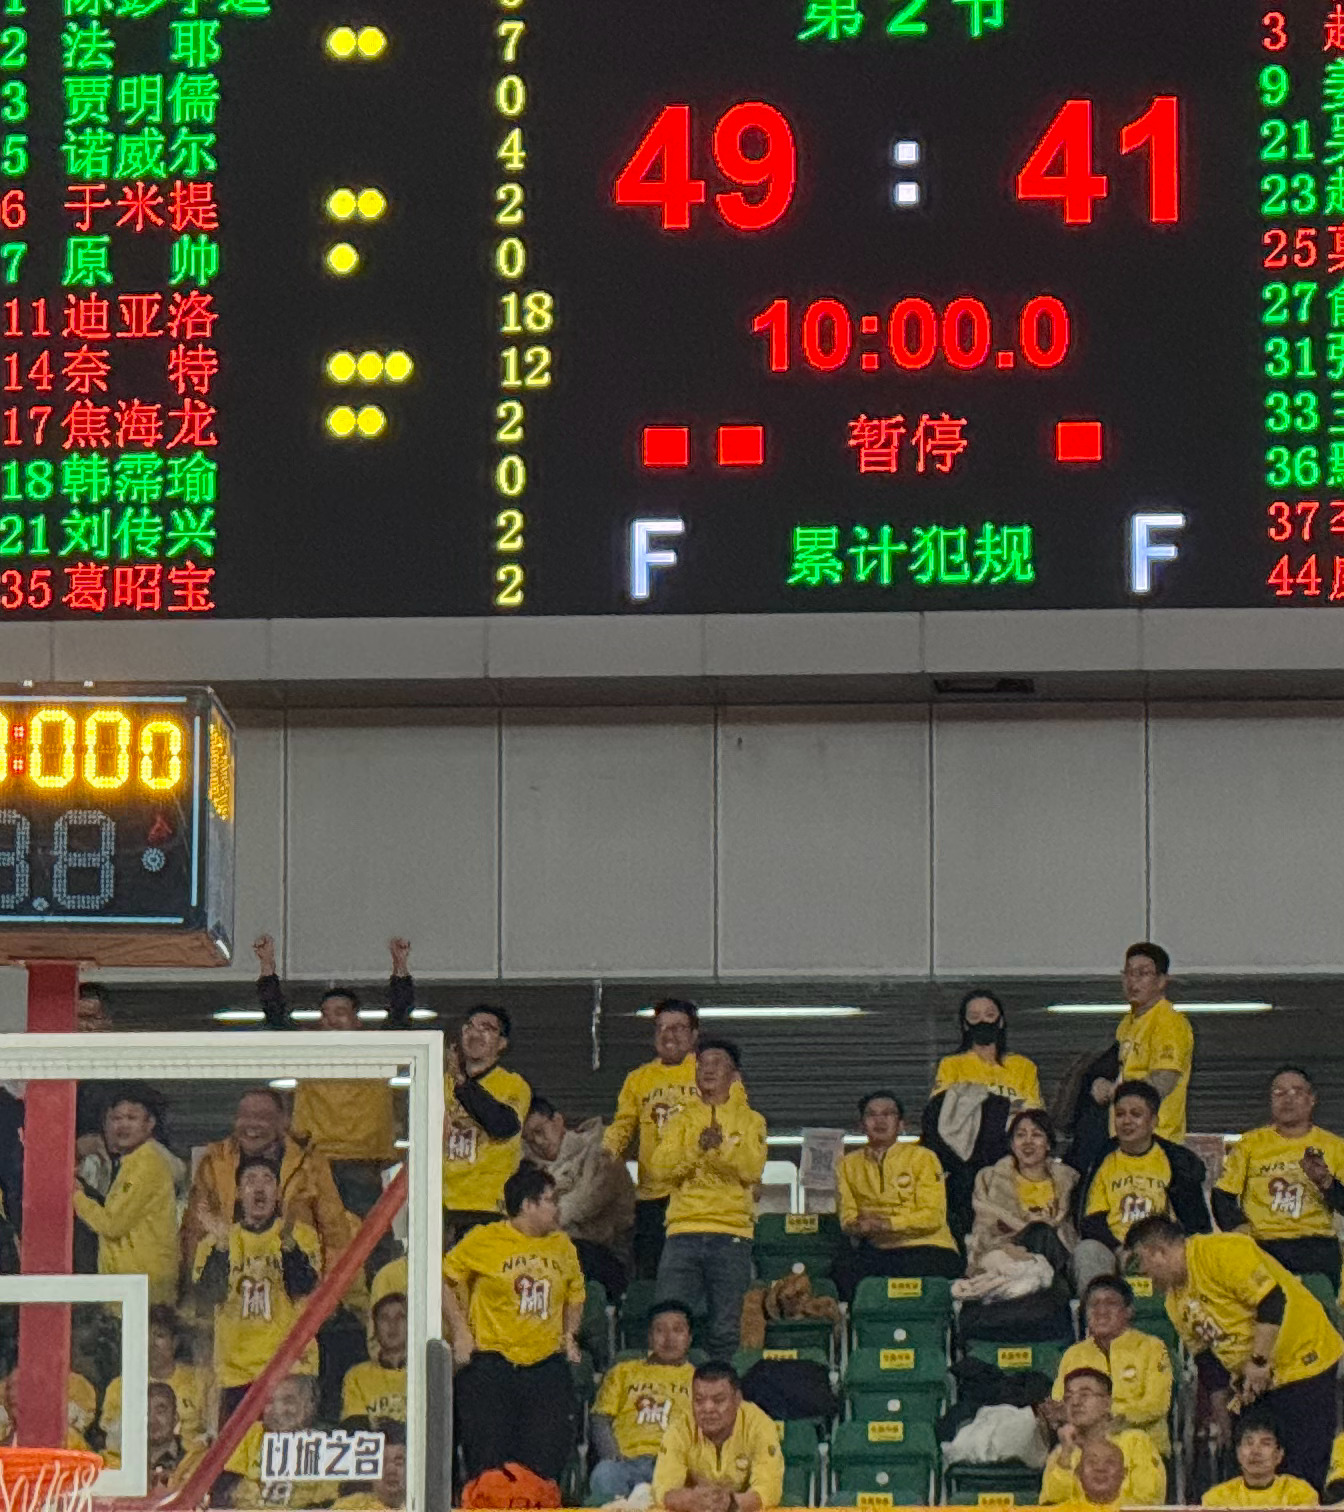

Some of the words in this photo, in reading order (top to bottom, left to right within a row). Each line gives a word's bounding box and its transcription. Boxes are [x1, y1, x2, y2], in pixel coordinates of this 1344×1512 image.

[0, 27, 27, 68] 2
[498, 21, 525, 61] 7
[1262, 12, 1287, 51] 3
[1, 80, 28, 122] 3
[64, 72, 220, 125] 贾明儒
[496, 75, 525, 116] 0
[1260, 65, 1289, 106] 9
[1, 134, 28, 176] 5
[60, 126, 217, 179] 诺威尔
[497, 128, 525, 170] 4
[1260, 120, 1314, 160] 21
[614, 102, 796, 232] 49
[1016, 96, 1178, 224] 41
[0, 190, 26, 229] 6
[64, 182, 218, 232] 于米提
[496, 184, 523, 224] 2
[1261, 174, 1317, 216] 23
[1, 242, 27, 282] 7
[496, 238, 525, 278] 0
[1264, 228, 1317, 268] 25
[4, 298, 50, 337] 11
[62, 290, 218, 340] 迪亚洛
[501, 292, 553, 333] 18
[1262, 282, 1318, 324] 27
[752, 296, 1070, 372] 10:00.0
[4, 350, 54, 391] 14
[501, 346, 551, 387] 12
[1265, 337, 1316, 378] 31
[4, 406, 52, 445] 17
[61, 398, 217, 448] 焦海龙
[497, 400, 523, 442] 2
[1266, 391, 1320, 432] 33
[848, 413, 967, 473] 暂停
[2, 460, 54, 501] 18
[496, 456, 525, 496] 0
[1266, 445, 1320, 487] 36
[59, 506, 216, 559] 刘传兴
[497, 510, 523, 551] 2
[1268, 500, 1319, 541] 37
[631, 519, 684, 598] F
[788, 523, 1034, 584] 累计犯规
[1131, 513, 1185, 592] F
[1268, 554, 1320, 596] 44
[0, 570, 52, 609] 35
[62, 562, 215, 612] 葛昭宝
[496, 564, 523, 605] 2
